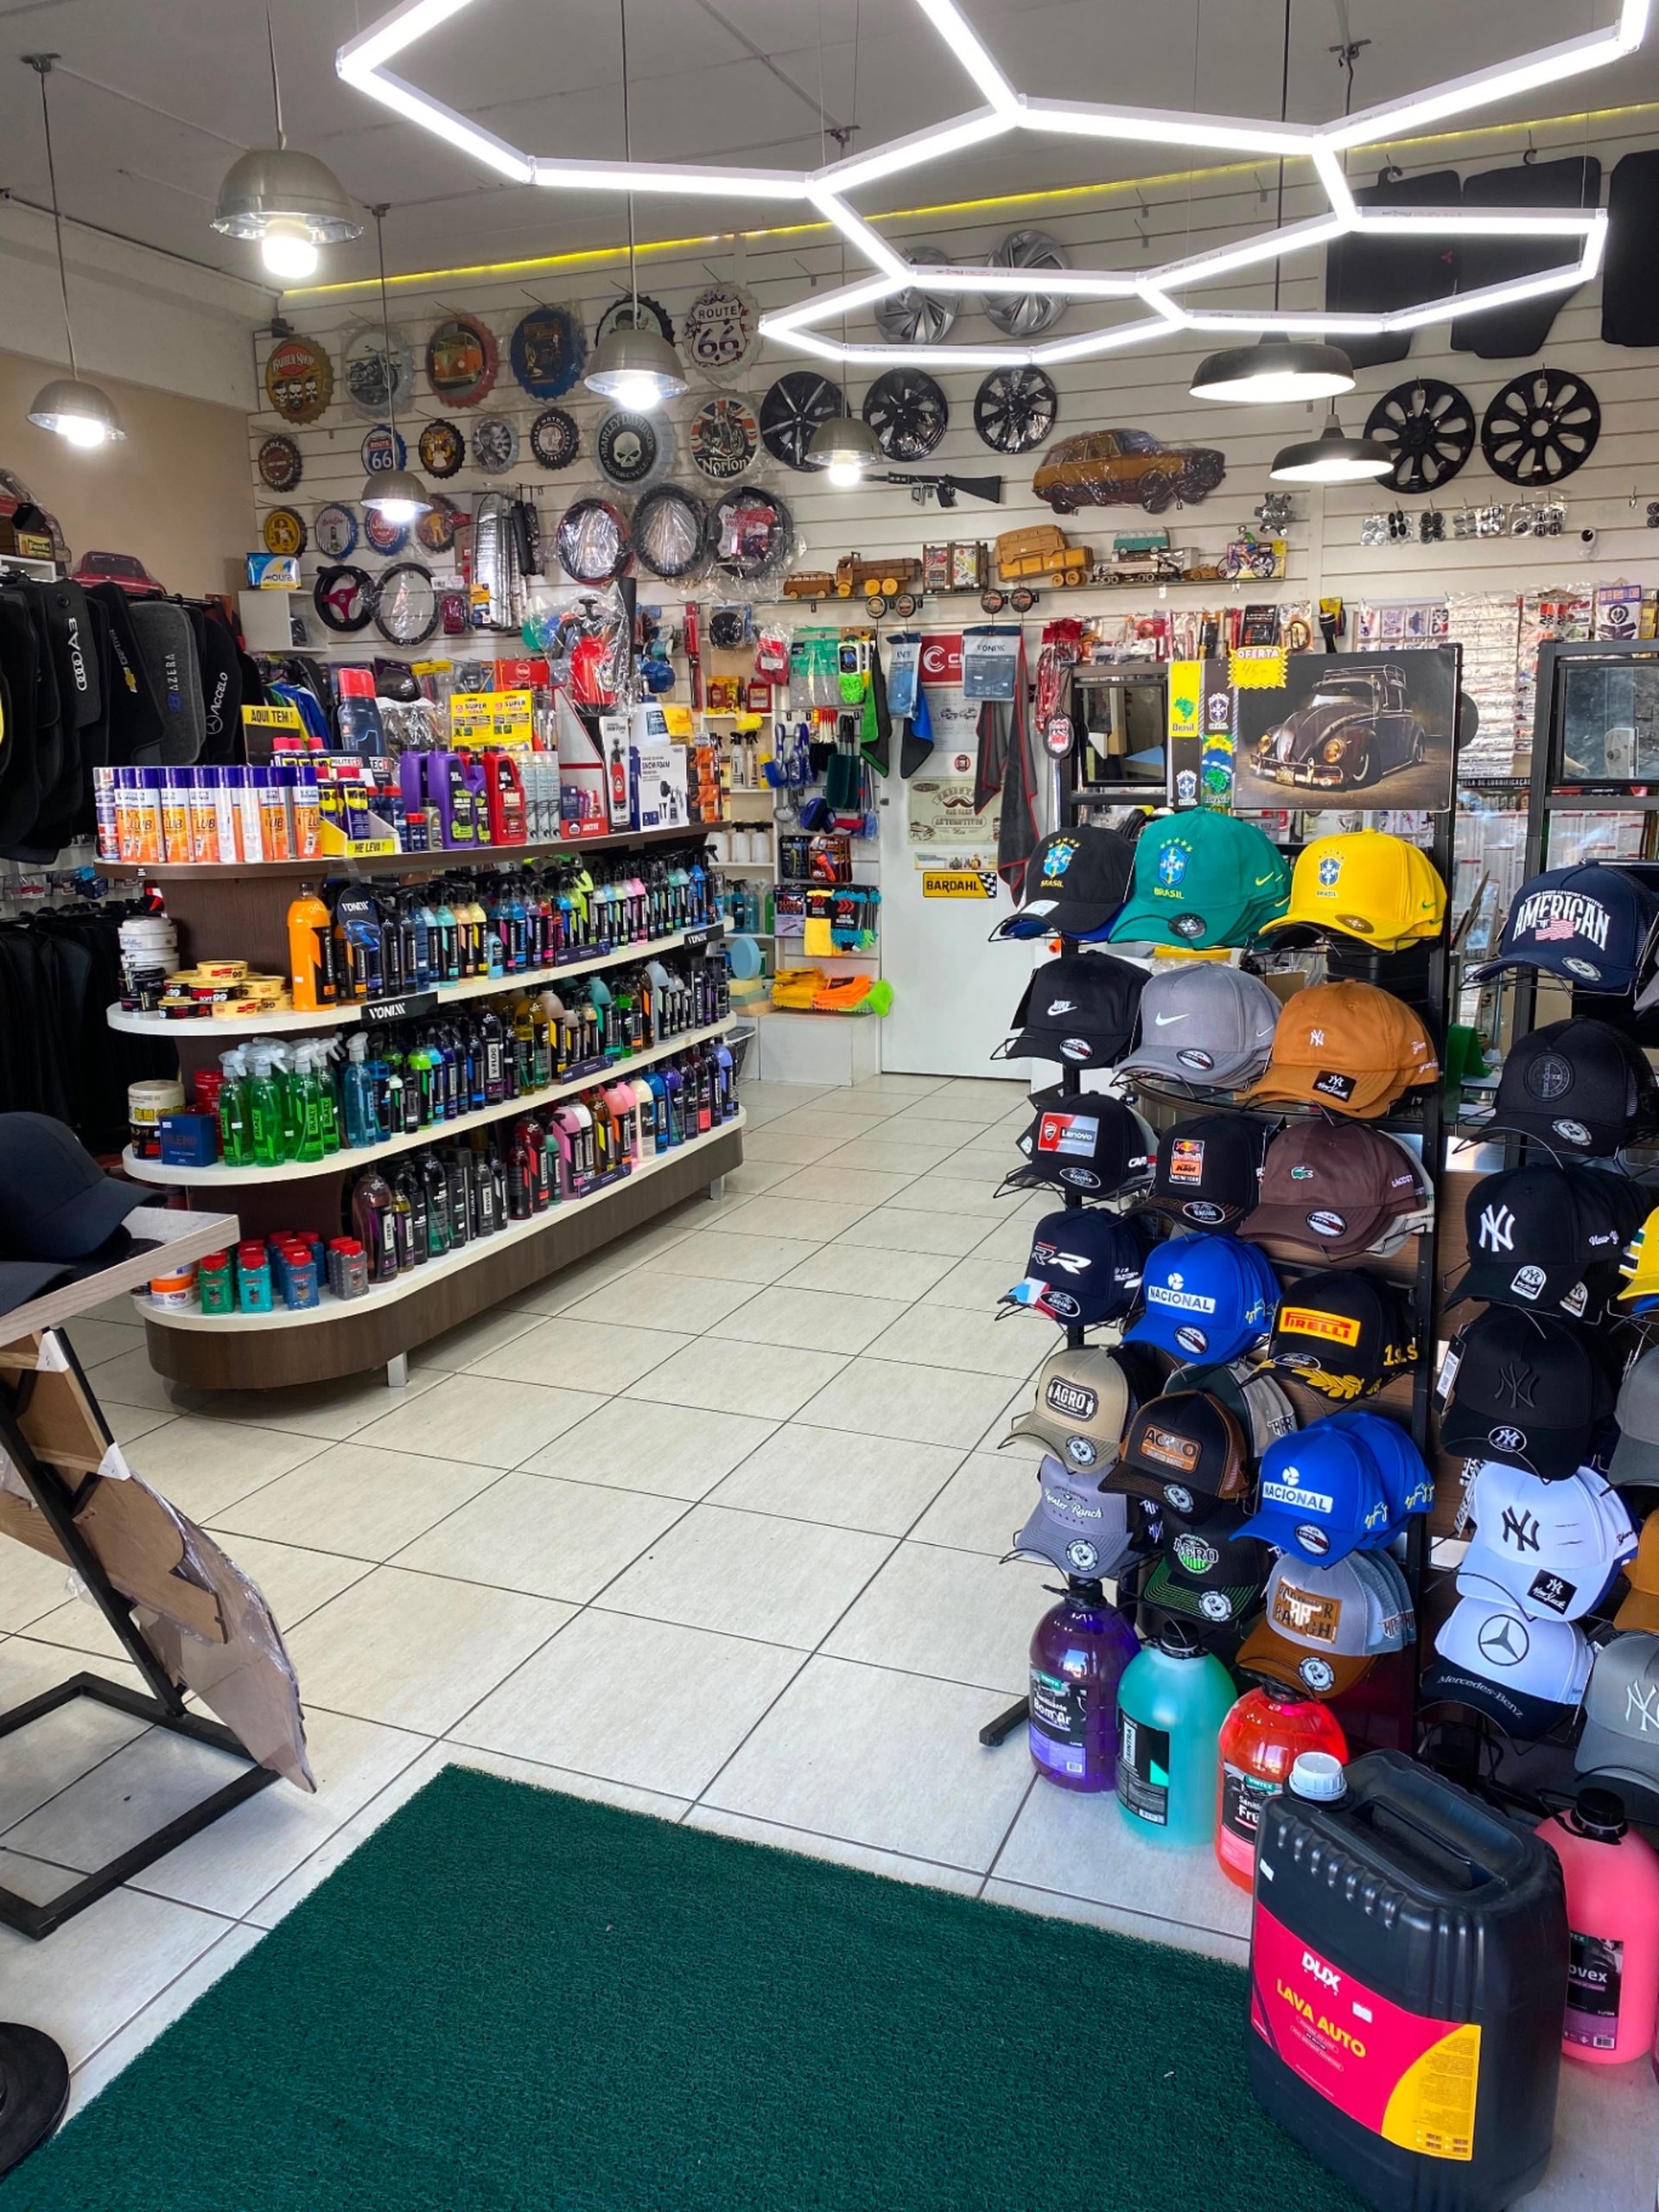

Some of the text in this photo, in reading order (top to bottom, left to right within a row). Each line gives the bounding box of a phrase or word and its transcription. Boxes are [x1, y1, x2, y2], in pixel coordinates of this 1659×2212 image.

[698, 305, 737, 320] ROUTE
[697, 326, 739, 358] 66
[370, 439, 391, 448] ROUTE
[372, 452, 393, 469] 66
[698, 457, 751, 477] Norton
[67, 617, 80, 651] A3
[1237, 649, 1281, 659] OFERTA
[166, 654, 180, 691] AZERA
[210, 672, 228, 716] ACCELO
[251, 709, 270, 722] AQUI
[1172, 723, 1194, 732] Brasil
[196, 818, 215, 830] LUB
[926, 880, 979, 893] BARDAHL
[1040, 880, 1064, 888] BRASIL
[1154, 887, 1185, 899] BRASIL
[1512, 895, 1611, 951] AMERICAN
[213, 993, 228, 1002] 99
[1054, 999, 1071, 1009] NIKE
[1309, 1028, 1325, 1046] NY
[1061, 1128, 1093, 1141] Lenovo
[1478, 1204, 1516, 1252] NY
[1150, 1287, 1212, 1312] NACIONAL
[1285, 1312, 1352, 1339] PIRELLI
[1053, 1384, 1087, 1410] AGRO
[1144, 1429, 1198, 1458] AGRO
[1495, 1429, 1520, 1447] NY
[1265, 1484, 1327, 1511] NACIONAL
[1071, 1503, 1103, 1519] Ranch
[1502, 1505, 1541, 1553] NY
[1173, 1538, 1219, 1564] AGRO
[1436, 1675, 1524, 1719] Mercedes-Benz
[1034, 1696, 1071, 1726] Bom Ar
[1302, 1950, 1342, 1995] DUX
[1277, 1978, 1315, 2024] LAVA
[1317, 2015, 1367, 2058] AUTO
